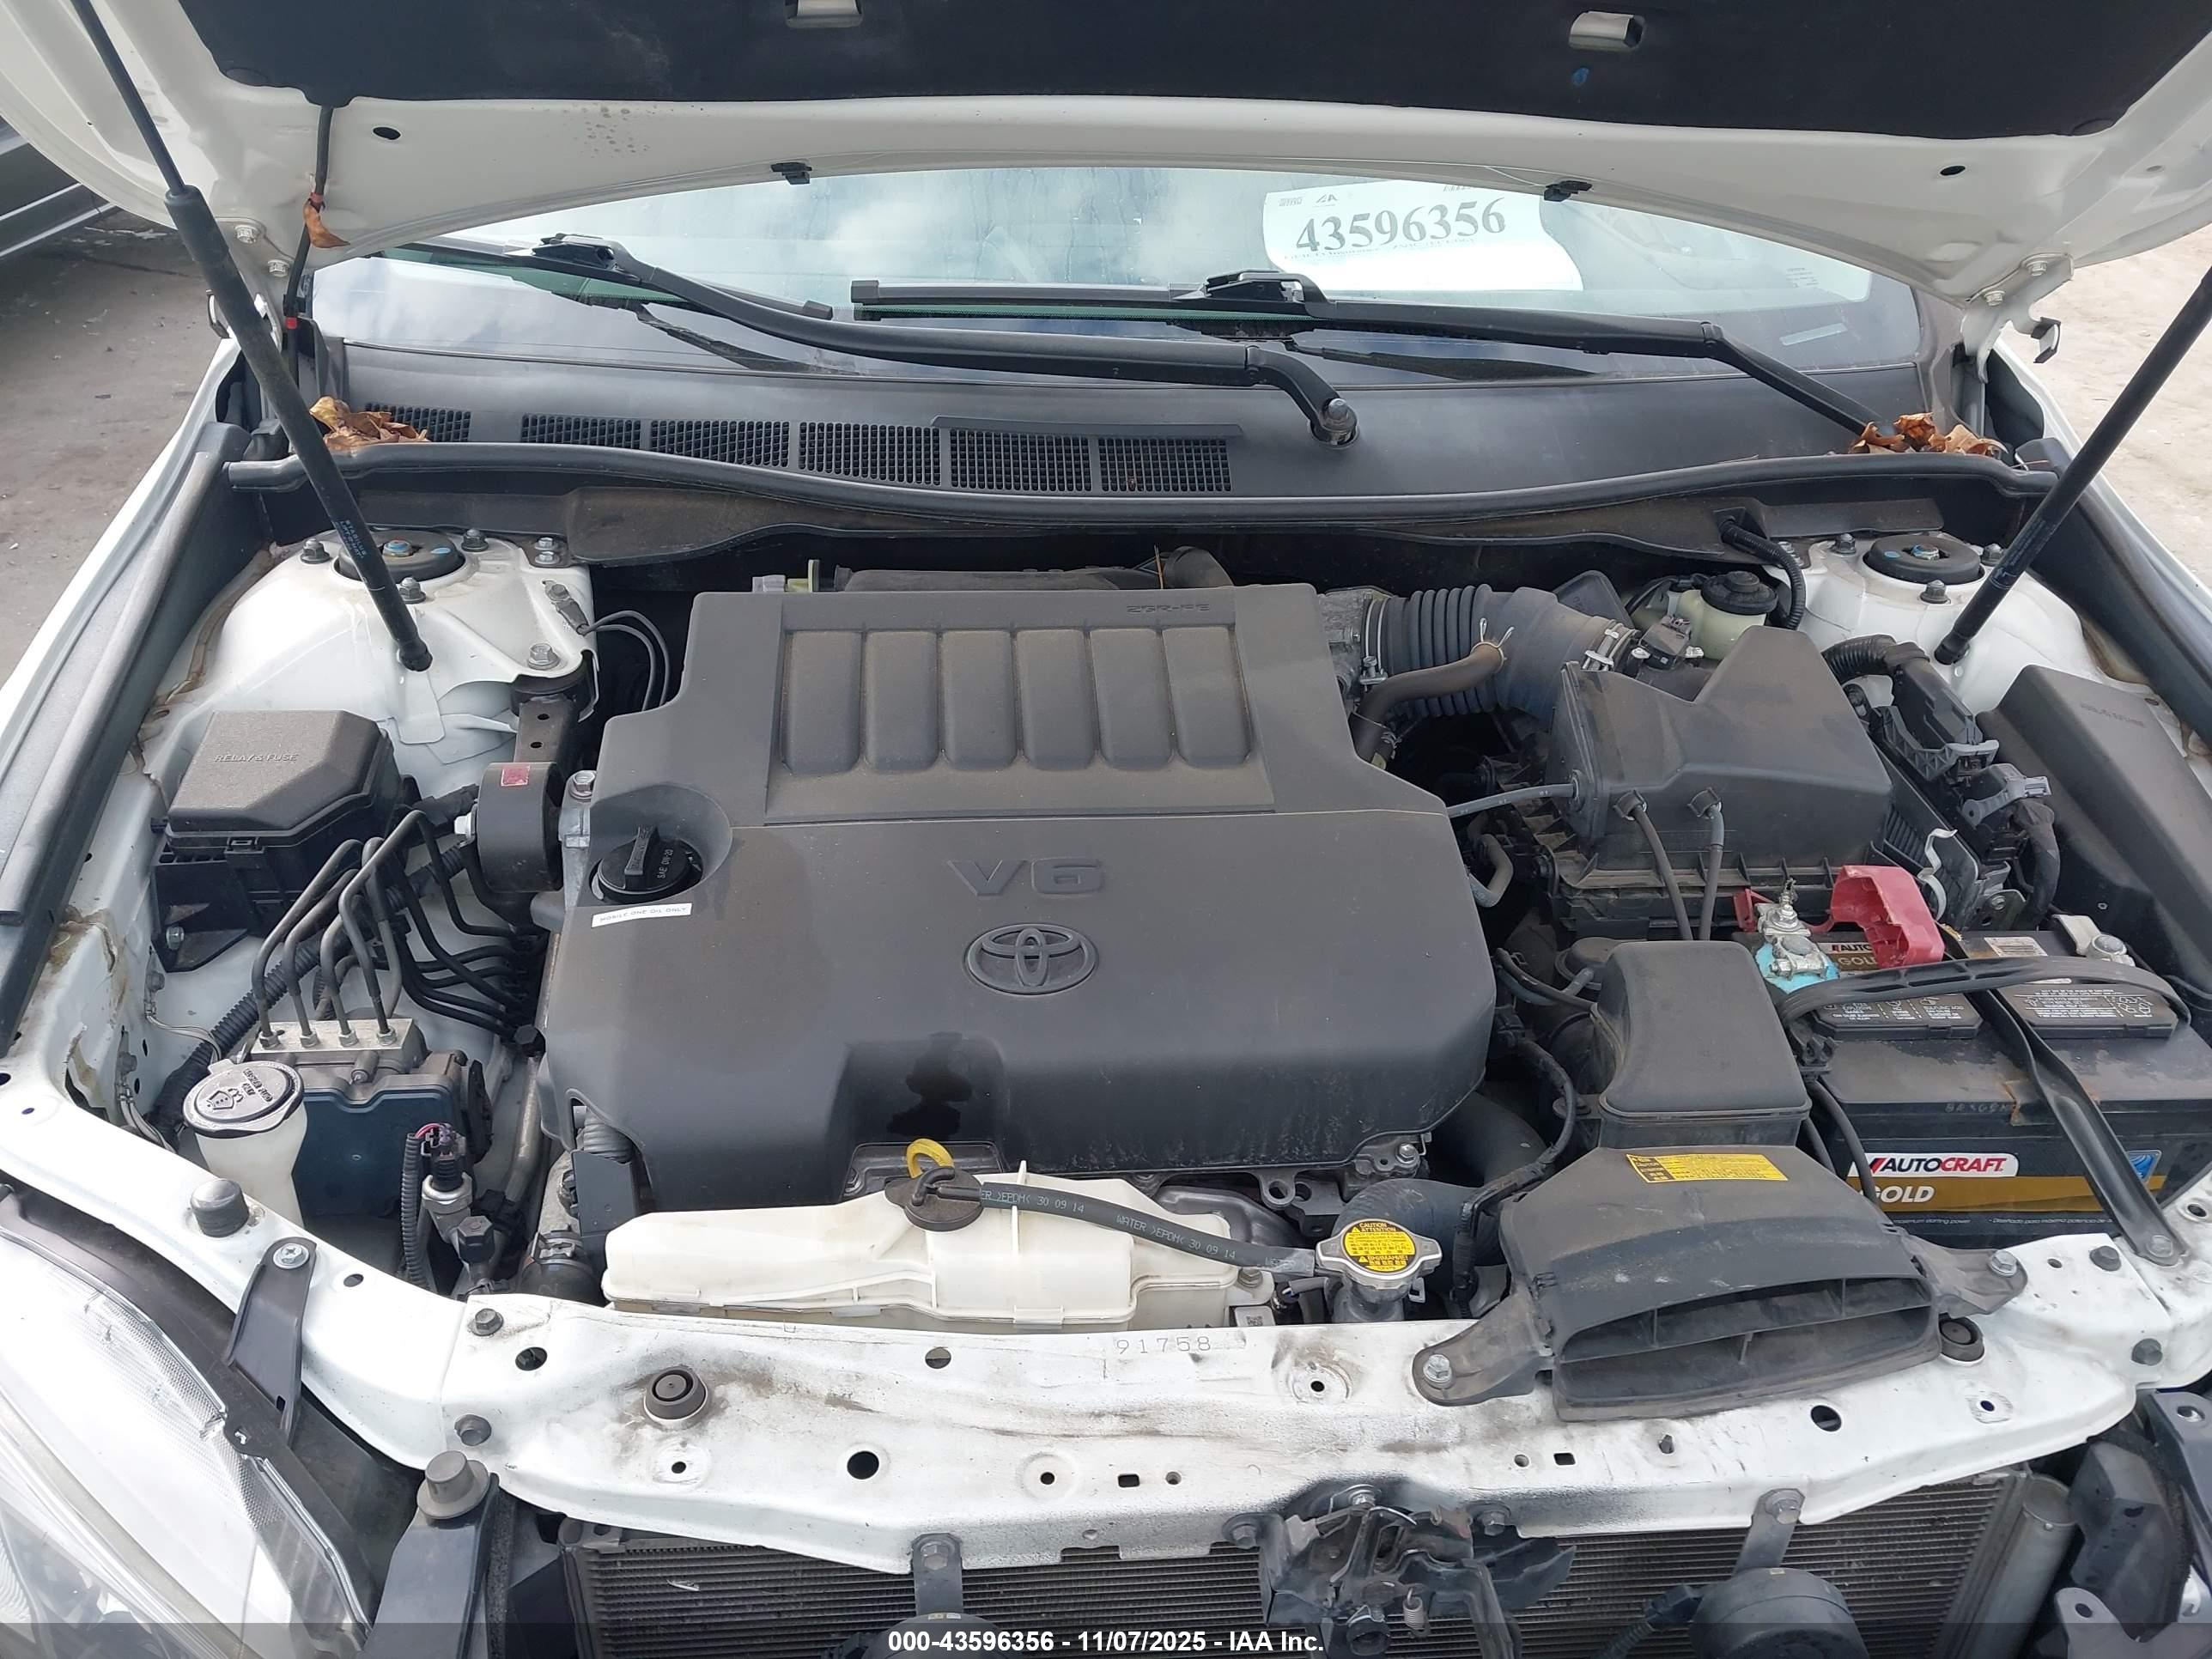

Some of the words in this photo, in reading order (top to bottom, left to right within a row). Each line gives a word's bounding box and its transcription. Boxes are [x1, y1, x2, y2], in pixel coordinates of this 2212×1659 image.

[1296, 198, 1506, 252] 43596356
[657, 866, 668, 879] SAE
[946, 857, 1103, 896] V6
[1881, 1157, 2005, 1173] AUTOCRAFT
[1037, 1194, 1049, 1206] 30
[1055, 1199, 1067, 1210] 09
[1073, 1202, 1085, 1214] 14
[1116, 1213, 1147, 1232] WATER
[1188, 1238, 1201, 1250] 30
[1206, 1244, 1219, 1255] 09
[1224, 1249, 1237, 1261] 14
[1116, 1336, 1211, 1355] 91758
